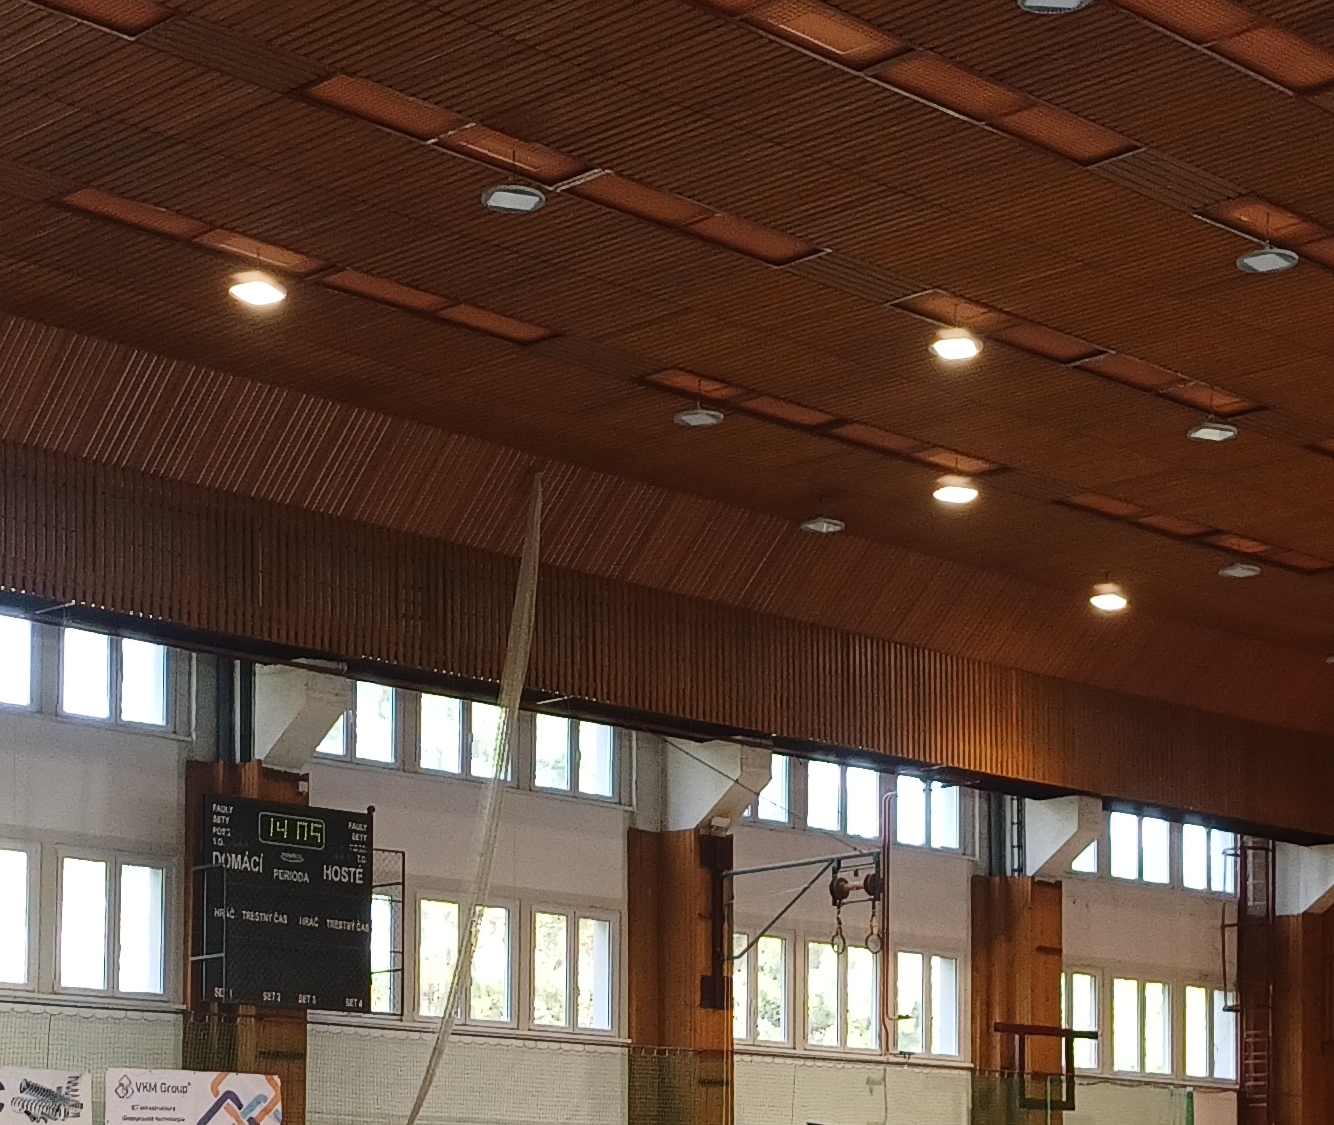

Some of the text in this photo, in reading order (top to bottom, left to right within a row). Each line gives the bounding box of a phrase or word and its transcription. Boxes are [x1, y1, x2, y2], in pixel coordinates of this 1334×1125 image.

[212, 850, 264, 874] DOMÁCÍ
[273, 868, 310, 883] PERIODA
[323, 864, 364, 884] HOSTÉ
[135, 1081, 158, 1094] VKM
